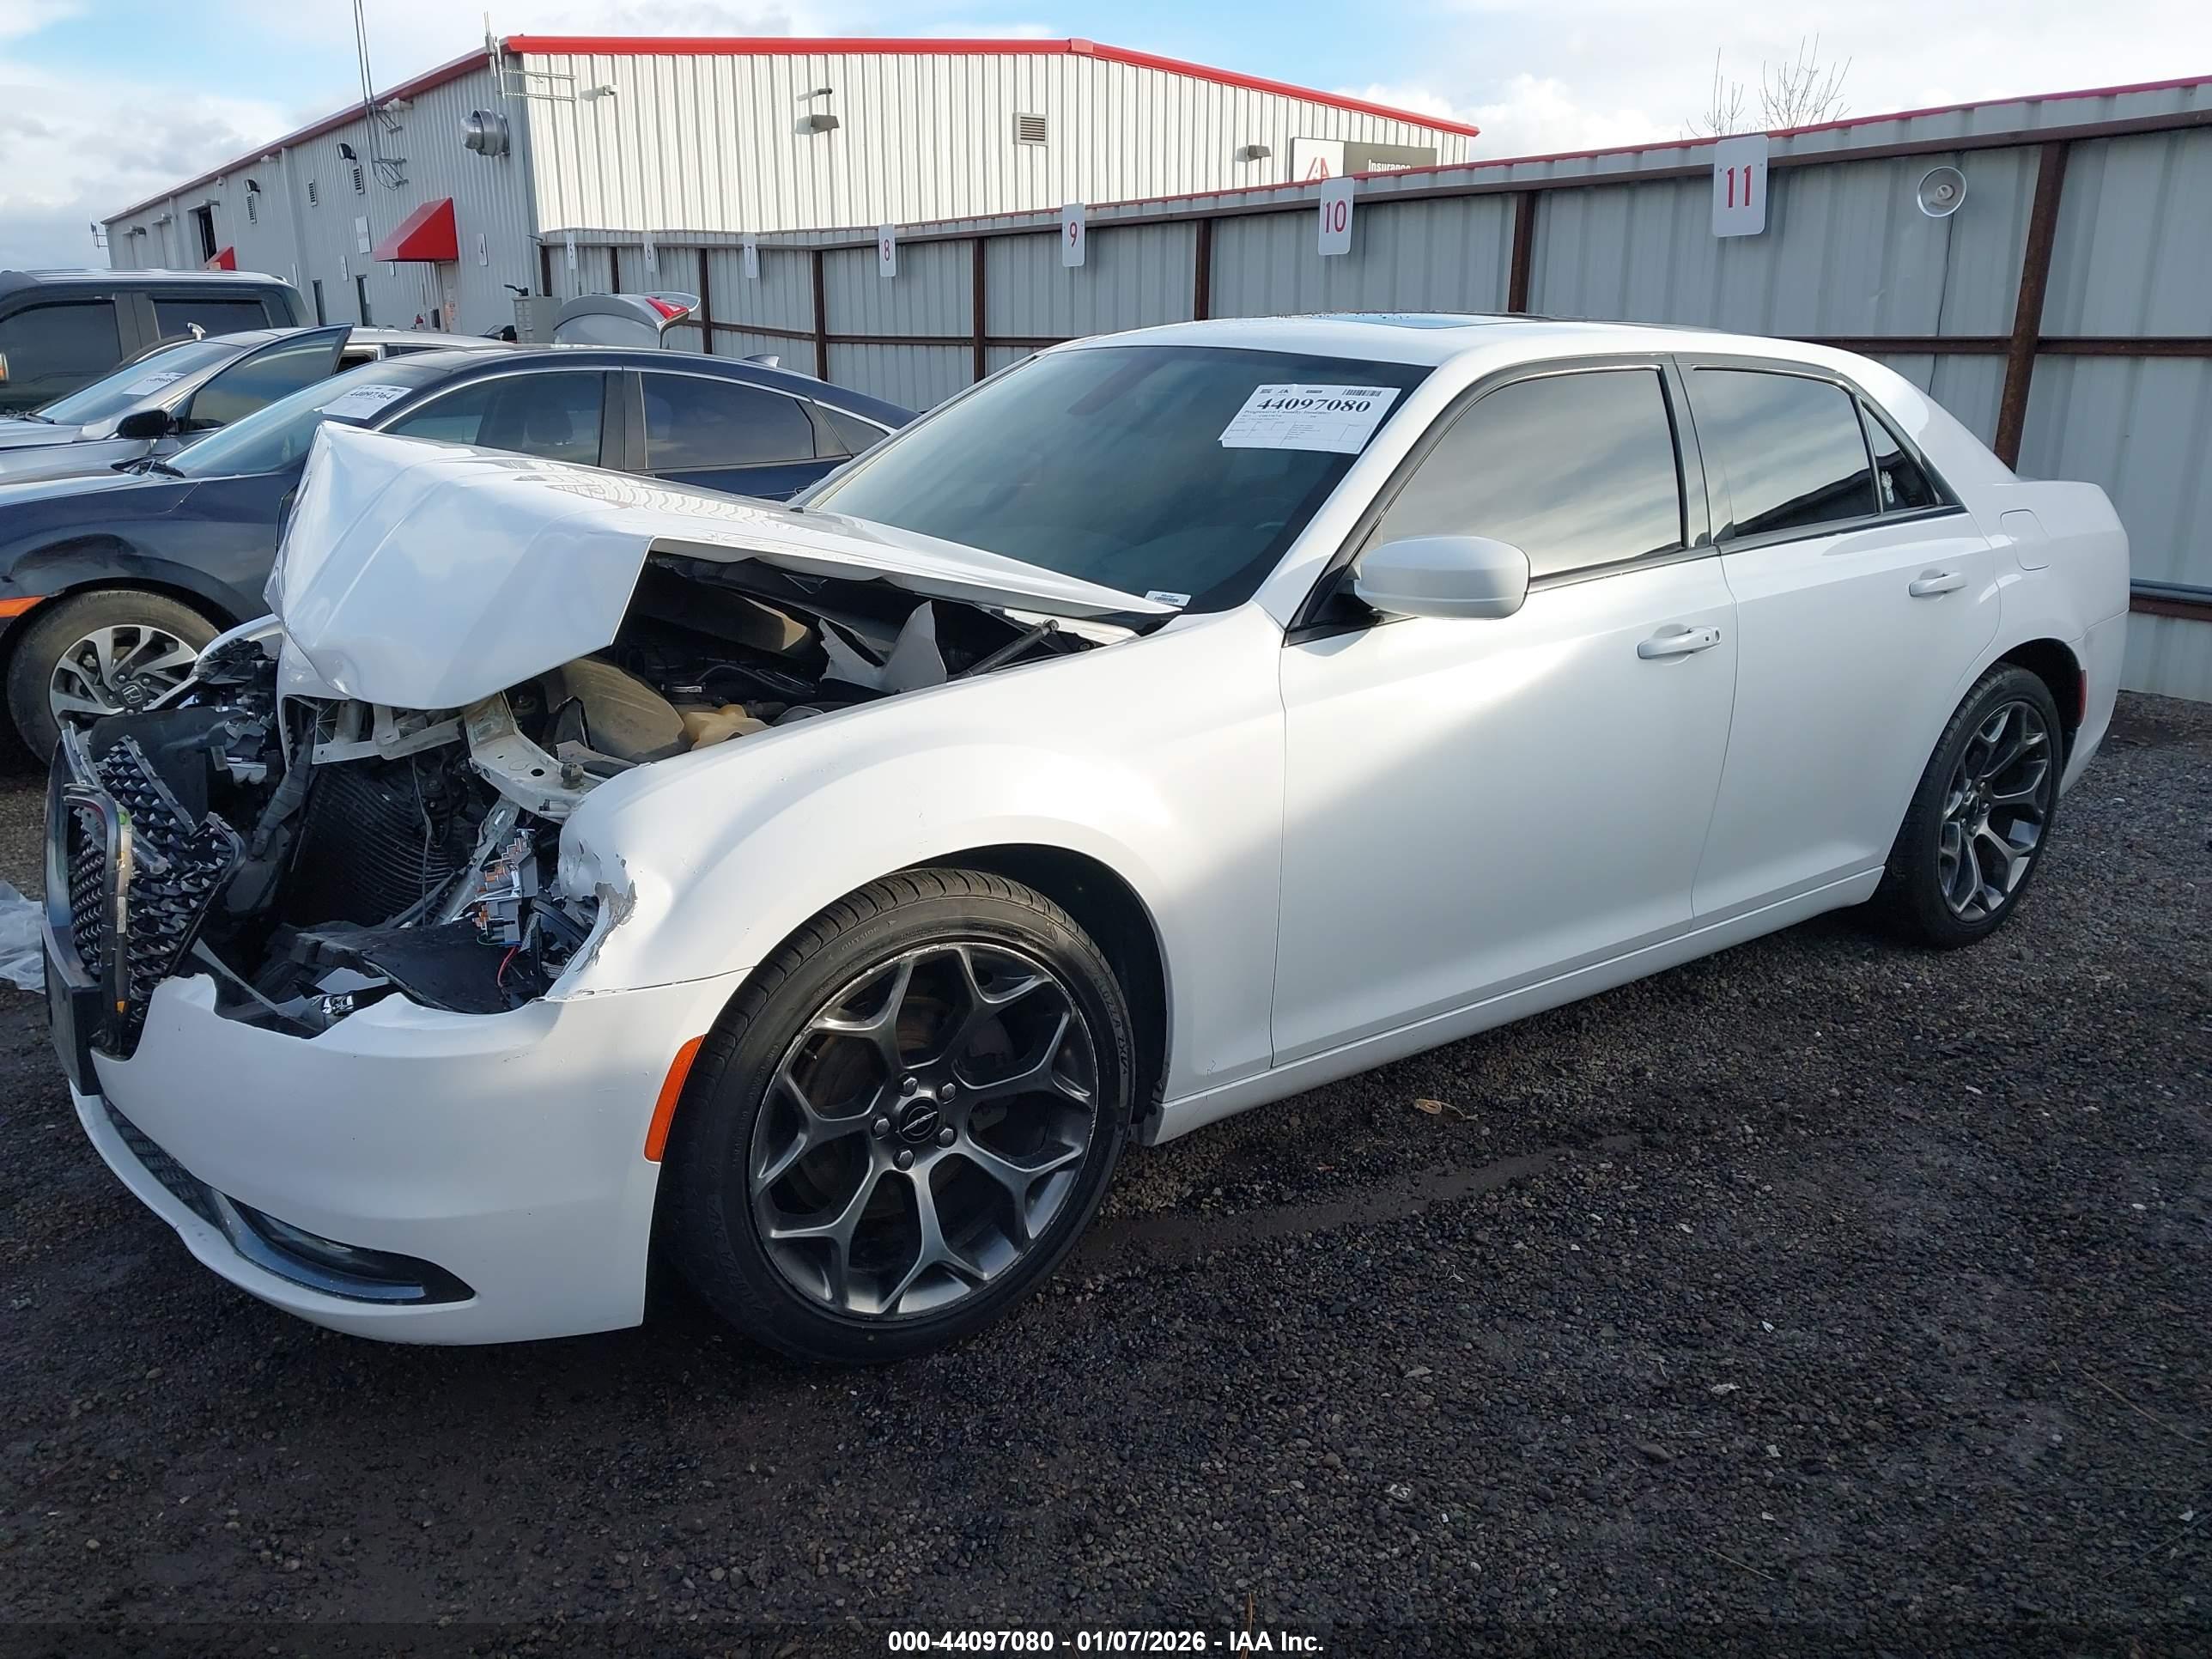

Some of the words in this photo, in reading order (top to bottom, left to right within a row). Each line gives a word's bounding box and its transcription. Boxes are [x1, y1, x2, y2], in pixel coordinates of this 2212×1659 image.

[1727, 165, 1752, 209] 11
[1325, 200, 1347, 234] 10
[1069, 222, 1078, 248] 9
[568, 243, 574, 259] 5
[647, 245, 652, 261] 6
[747, 246, 752, 265] 7
[884, 239, 890, 262] 8
[1256, 398, 1371, 413] 44097080
